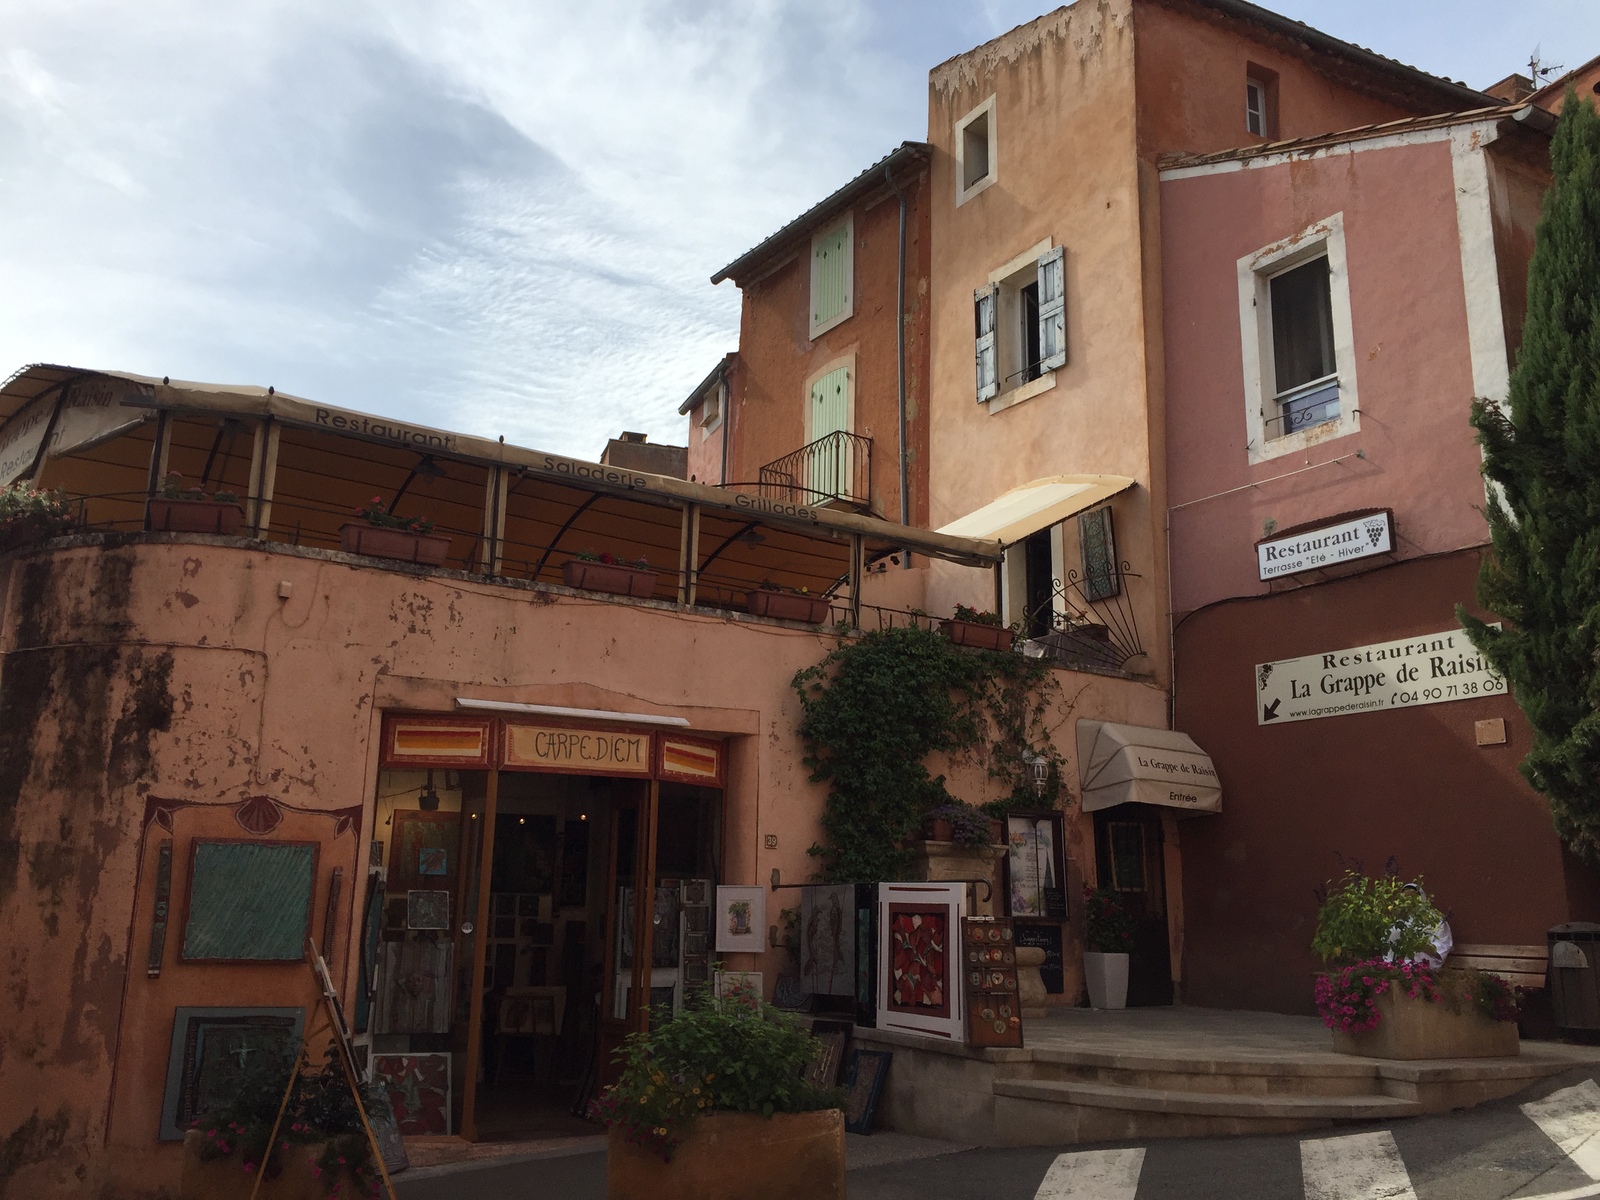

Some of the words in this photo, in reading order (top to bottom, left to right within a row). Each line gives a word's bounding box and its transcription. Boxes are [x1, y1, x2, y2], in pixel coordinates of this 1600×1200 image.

[315, 408, 451, 449] Restaurant
[543, 457, 647, 488] Saladerie
[735, 494, 818, 520] Grillades
[1265, 526, 1361, 562] Restaurant
[1263, 560, 1303, 576] Terrasse
[1322, 635, 1456, 670] Restaurant
[1290, 679, 1311, 699] La
[1320, 669, 1386, 697] Grappe
[1396, 663, 1420, 684] de
[1289, 699, 1385, 718] www.lagrappederaisin.fr
[1400, 691, 1419, 704] 04
[1423, 687, 1442, 700] 90
[1446, 684, 1458, 697] 71
[1462, 681, 1478, 695] 38
[1483, 678, 1504, 692] 06
[1138, 756, 1149, 768] La
[1150, 758, 1179, 773] Grappe
[1180, 763, 1190, 773] de
[1191, 764, 1216, 777] Raisin
[1169, 791, 1198, 803] Entrée
[767, 836, 777, 846] 39
